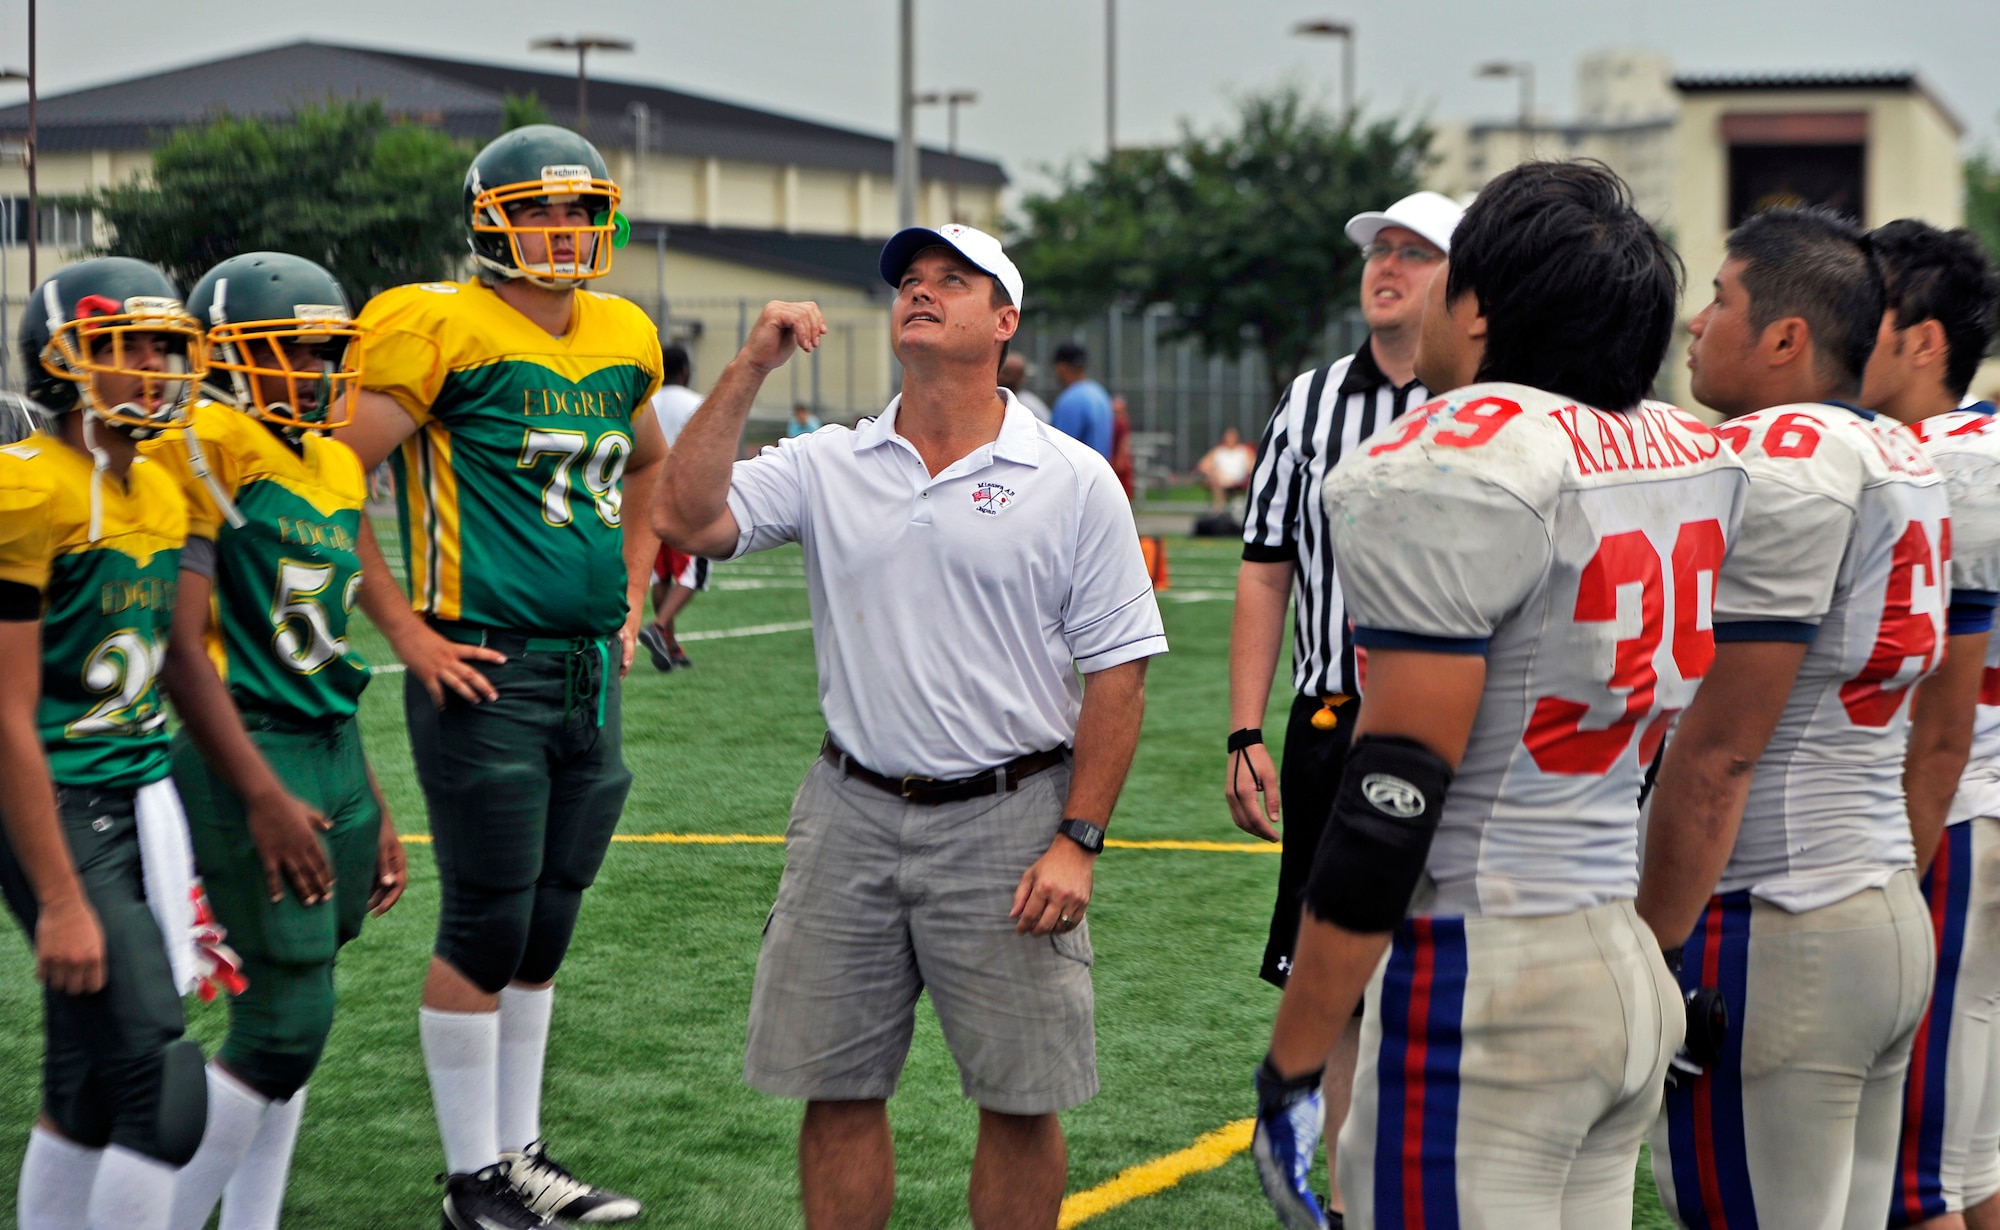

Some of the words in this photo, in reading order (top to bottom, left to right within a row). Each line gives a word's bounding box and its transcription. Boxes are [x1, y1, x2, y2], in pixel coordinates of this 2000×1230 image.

[522, 388, 627, 418] EDGREN
[1368, 396, 1524, 457] 39
[1550, 405, 1720, 476] KAYAKS
[516, 427, 634, 528] 79
